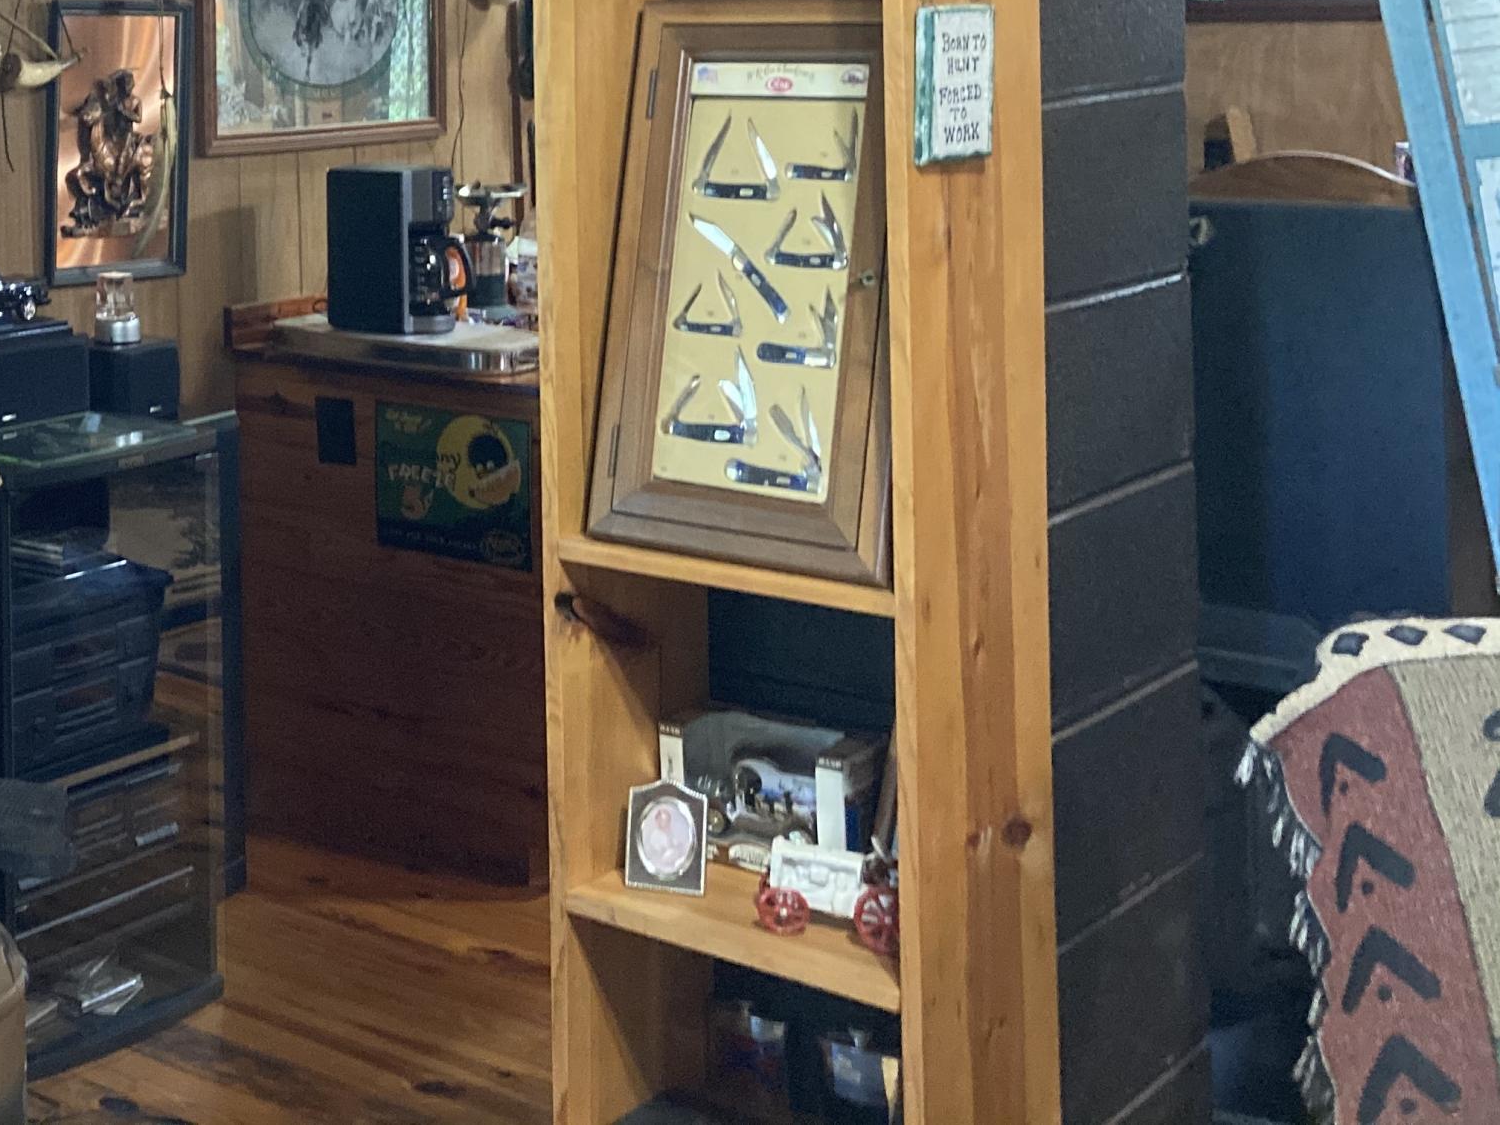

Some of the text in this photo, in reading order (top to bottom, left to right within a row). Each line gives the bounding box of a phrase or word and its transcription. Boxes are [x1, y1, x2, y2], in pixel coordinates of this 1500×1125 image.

[942, 32, 987, 53] BORN TO
[947, 57, 980, 75] HUNT
[939, 84, 981, 105] FORCED
[950, 107, 967, 121] TO
[944, 123, 980, 144] WORK
